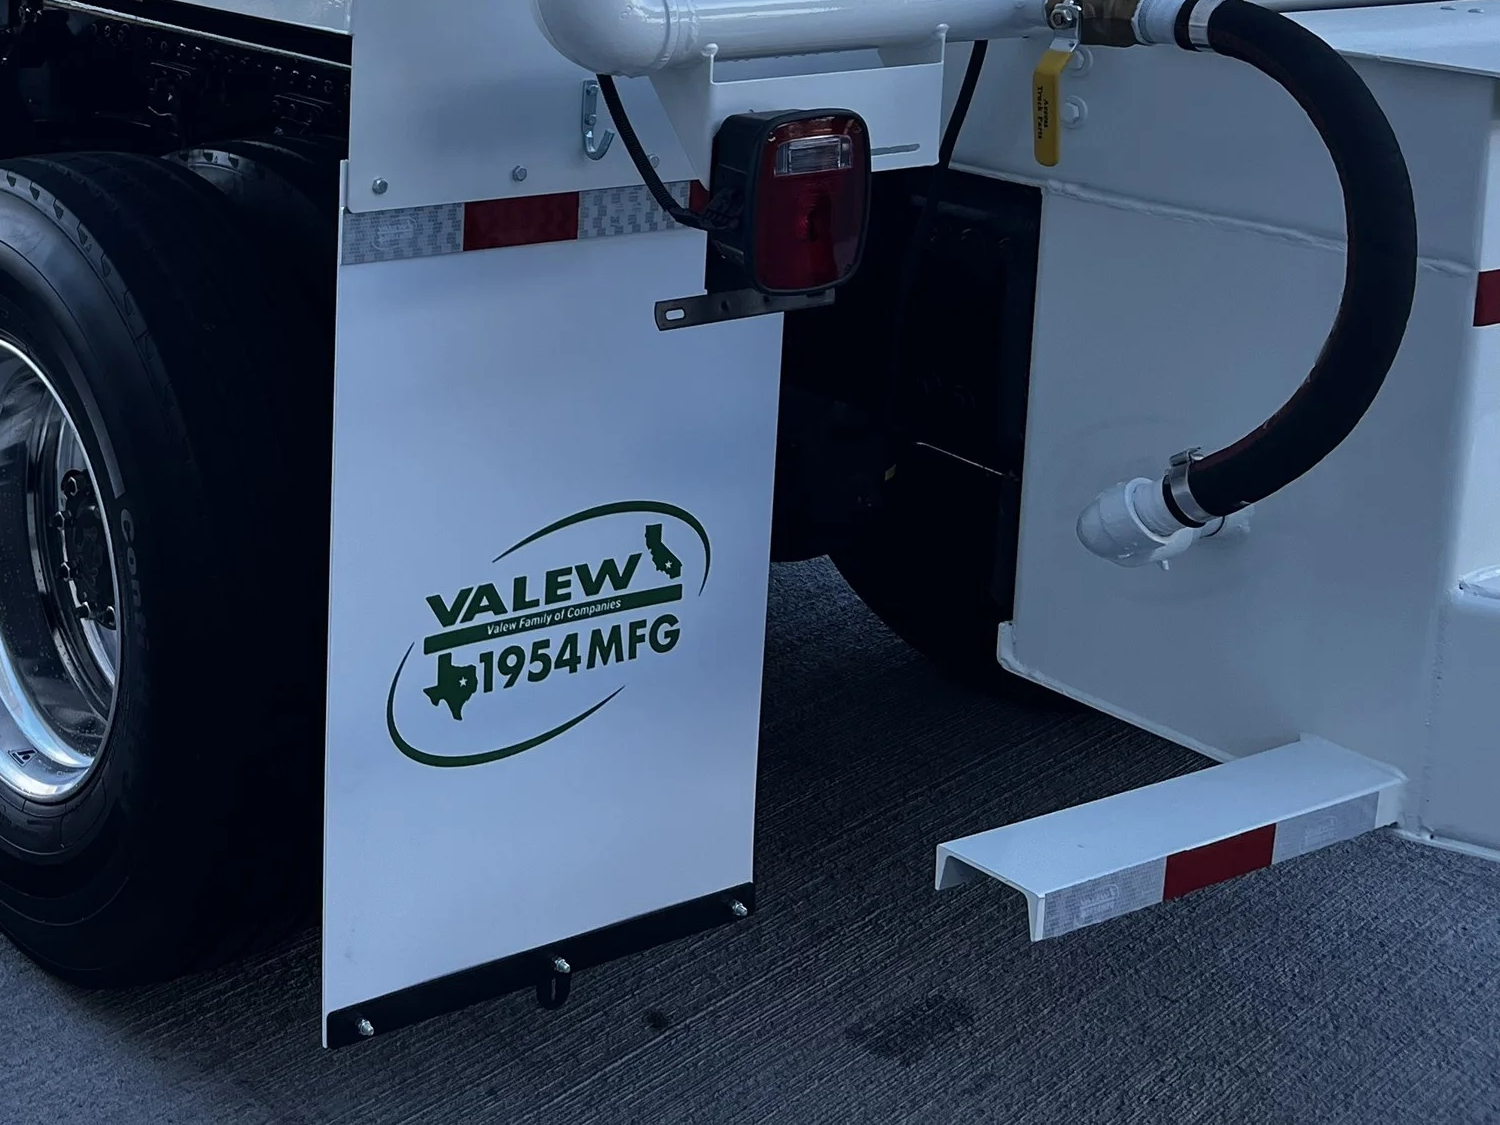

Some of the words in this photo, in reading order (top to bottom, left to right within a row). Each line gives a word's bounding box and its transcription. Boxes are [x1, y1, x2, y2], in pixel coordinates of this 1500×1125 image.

[425, 552, 643, 628] VALEW
[487, 621, 517, 635] Valew
[519, 612, 552, 629] Family
[554, 610, 565, 621] of
[567, 599, 622, 618] Companies
[478, 614, 681, 694] 1954MFG
